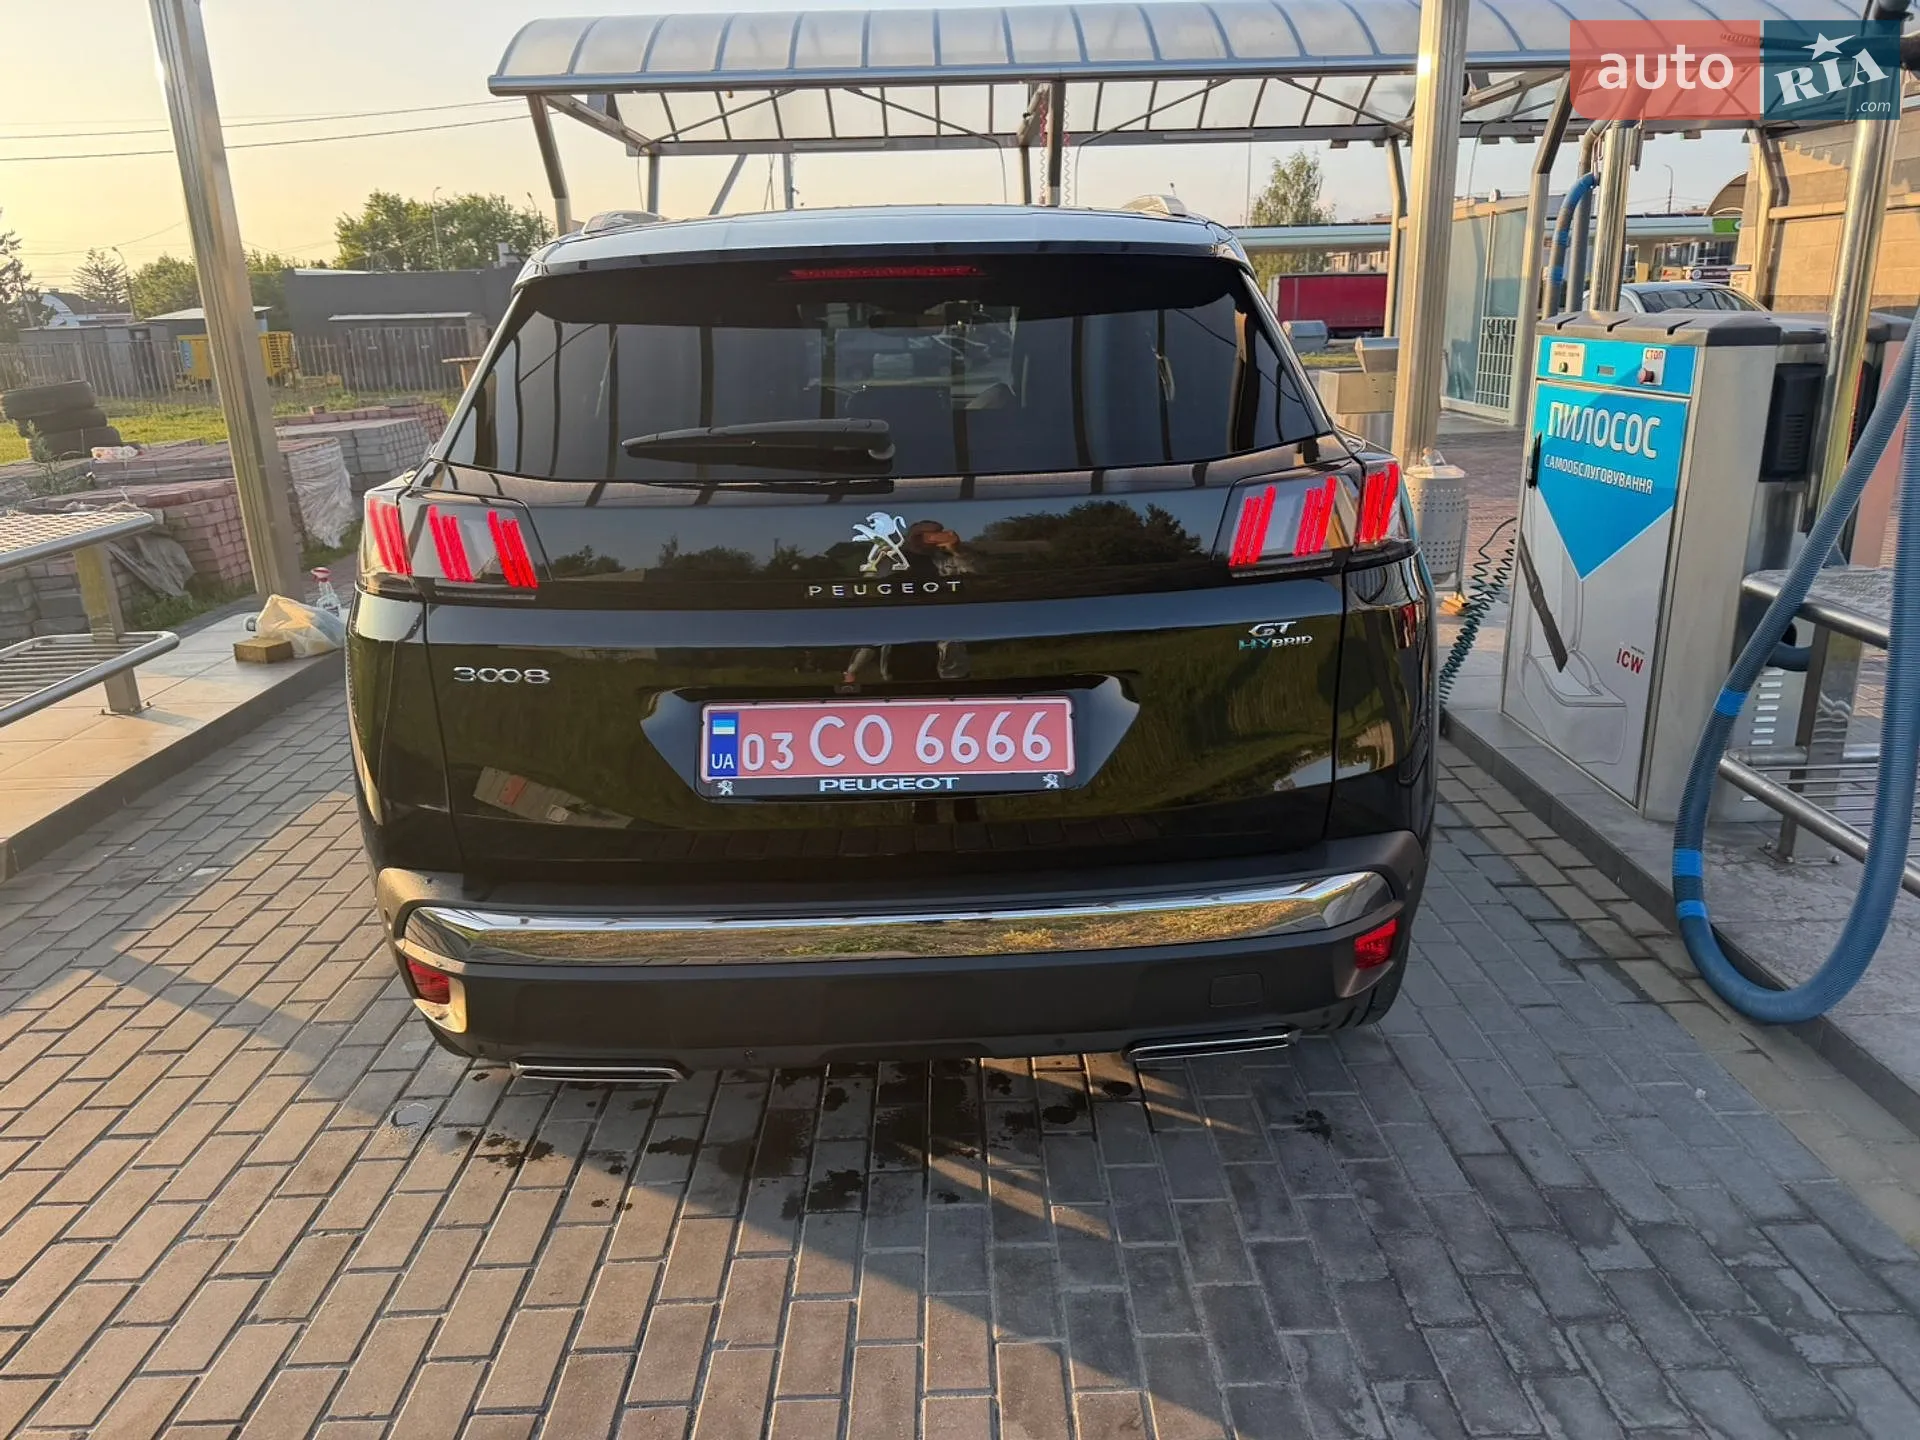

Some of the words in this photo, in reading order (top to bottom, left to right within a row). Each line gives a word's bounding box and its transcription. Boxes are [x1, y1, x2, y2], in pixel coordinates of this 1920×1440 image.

[1645, 349, 1664, 360] СТОП
[1547, 401, 1661, 459] ПИЛОСОС
[1544, 454, 1653, 495] САМООБСЛУГОВУВАННЯ
[808, 581, 961, 596] PEUGEOT
[1248, 621, 1297, 637] GT
[1238, 635, 1313, 651] HYBRID
[1616, 647, 1643, 674] ICW
[453, 666, 551, 684] 3008
[742, 733, 794, 771] 03
[809, 714, 893, 767] CO
[915, 711, 1052, 765] 6666
[711, 753, 735, 769] UA
[819, 777, 959, 791] PEUGEOT
